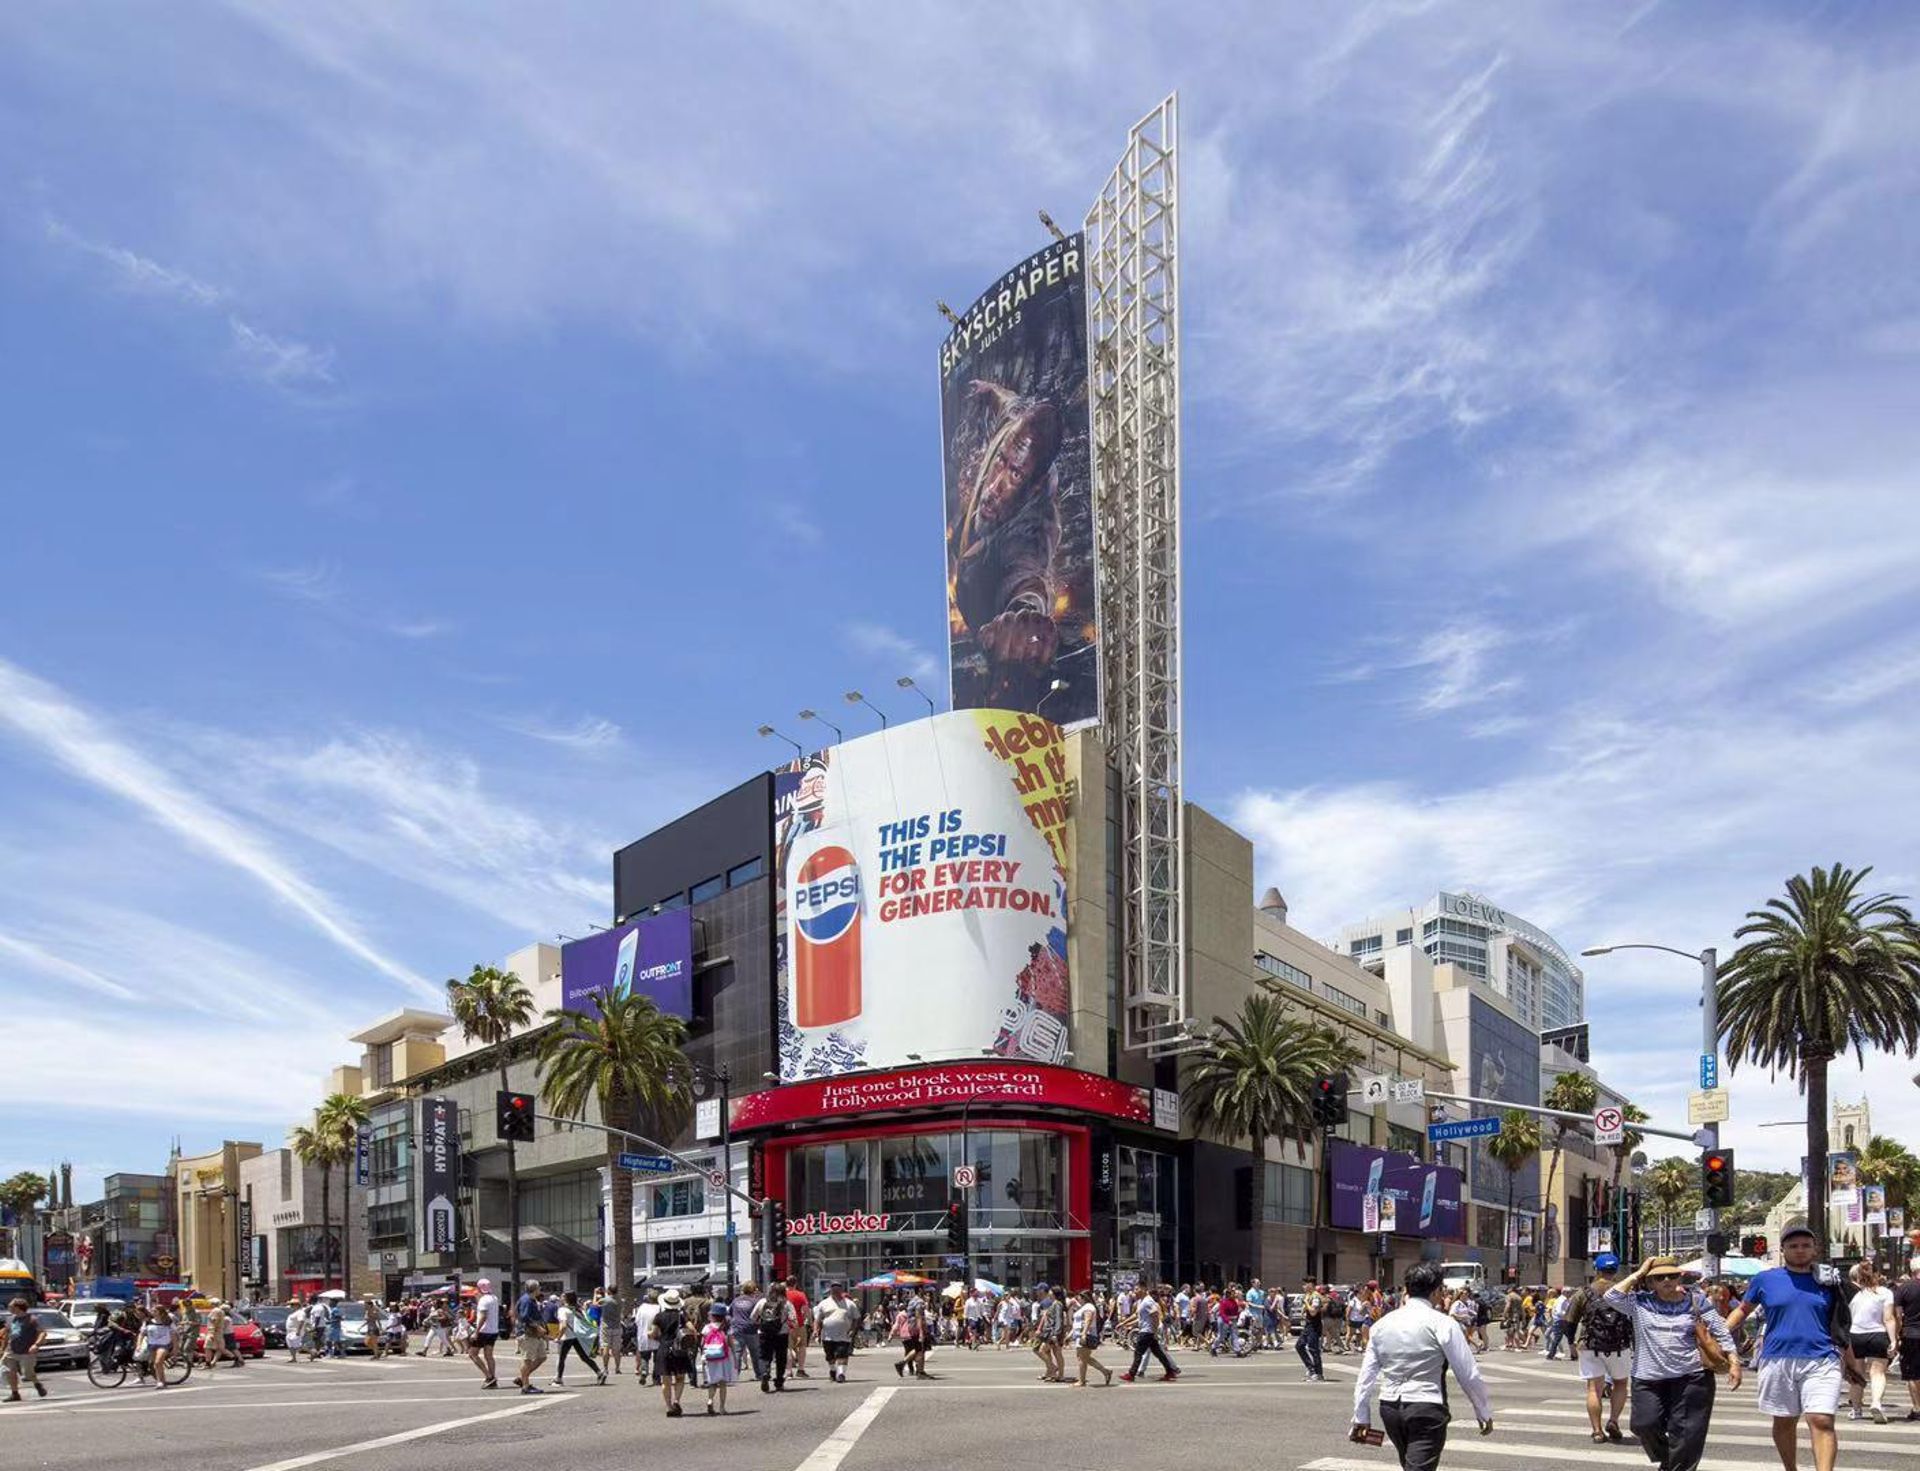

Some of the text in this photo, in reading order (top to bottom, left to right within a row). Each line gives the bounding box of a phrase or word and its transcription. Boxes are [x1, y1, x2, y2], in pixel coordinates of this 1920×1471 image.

[999, 237, 1077, 292] JOHNSON
[943, 250, 1079, 377] SKYSCRAPER
[980, 311, 1021, 354] JULY 13
[878, 809, 962, 847] THIS IS
[879, 834, 1006, 872] THE PEPSI
[795, 874, 860, 909] PEPSI
[879, 860, 1021, 898] FOR EVERY
[879, 887, 1056, 922] GENERATION.
[640, 960, 682, 980] OUTFRONT
[822, 1083, 1044, 1109] Hollywood Boulevard!
[823, 1072, 1041, 1098] Just one block west on
[1434, 1122, 1494, 1138] Hollywood
[1608, 1133, 1620, 1141] RED
[624, 1157, 656, 1168] Highland
[883, 1184, 924, 1200] SIX:02
[242, 1206, 250, 1238] THEATRE
[819, 1209, 890, 1234] Locker
